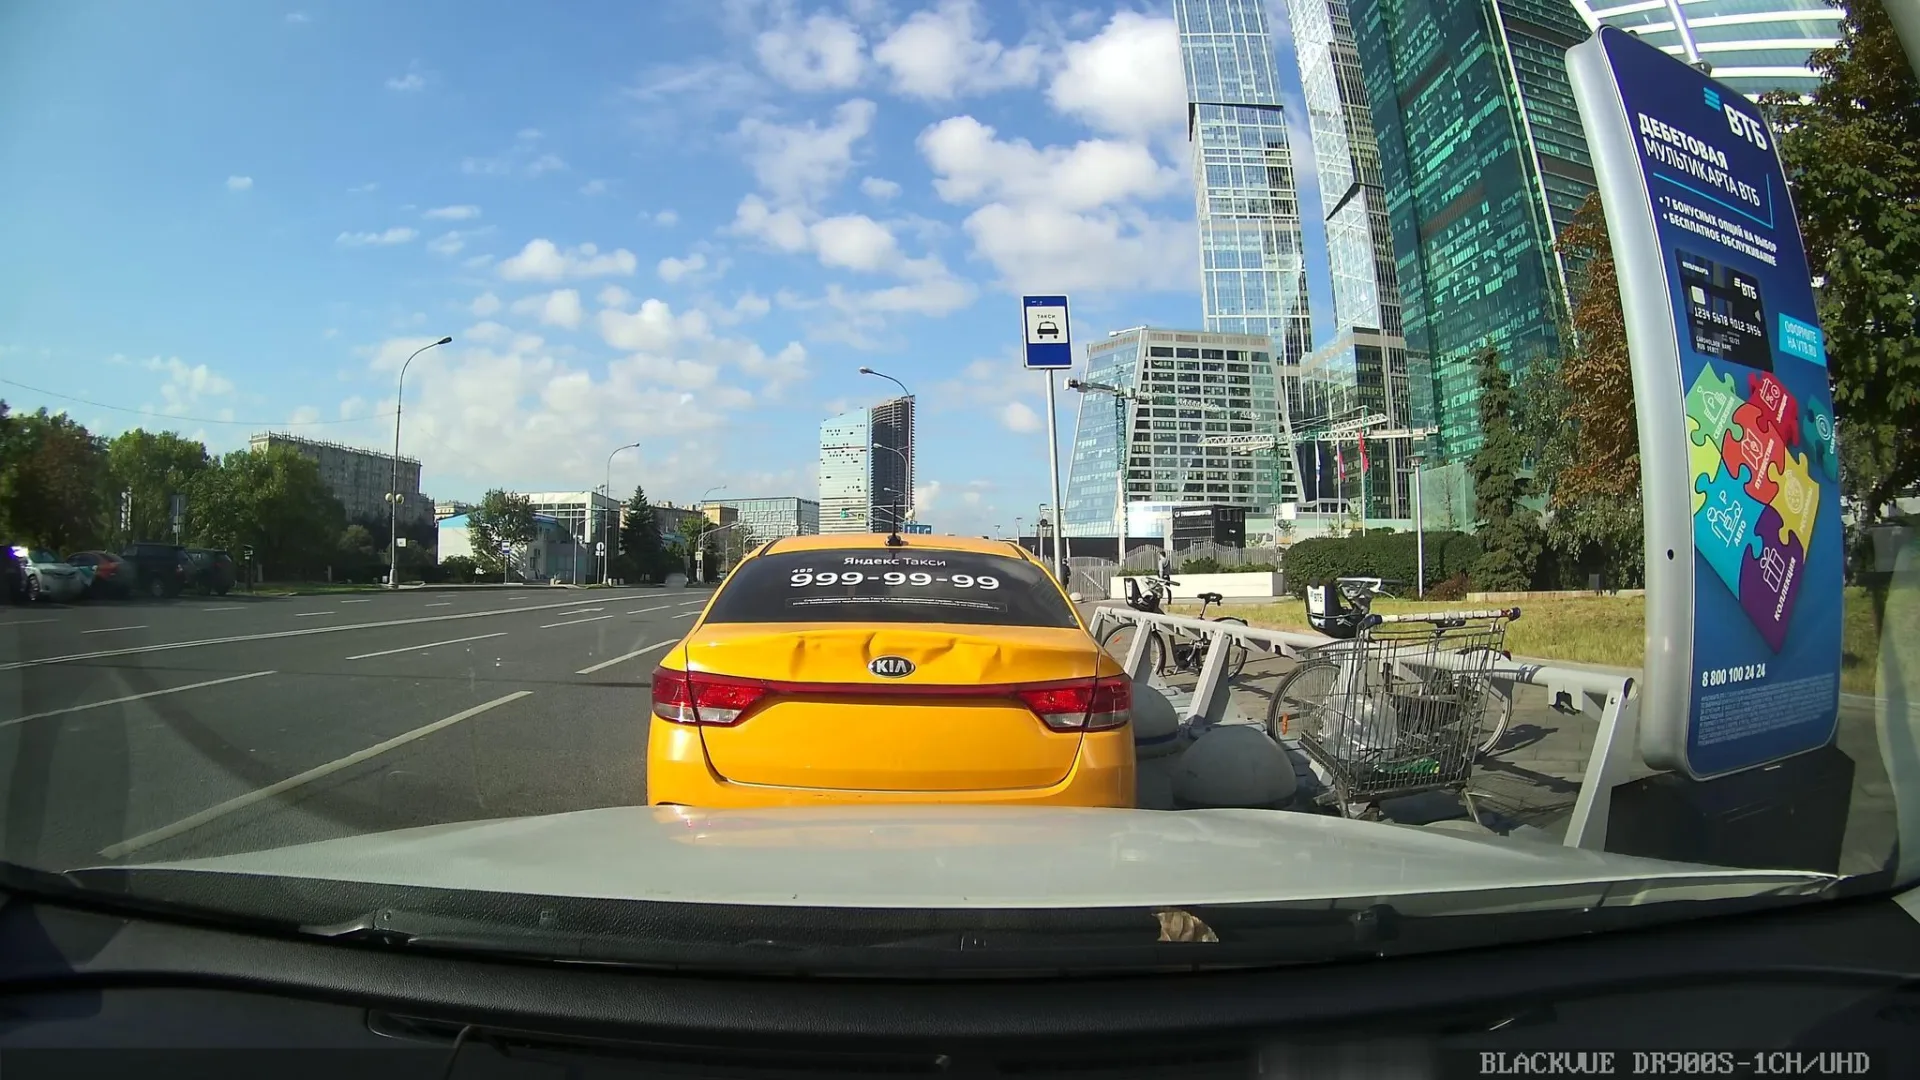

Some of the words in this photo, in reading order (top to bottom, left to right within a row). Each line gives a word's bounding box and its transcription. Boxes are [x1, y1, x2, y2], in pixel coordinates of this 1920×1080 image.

[1638, 112, 1729, 171] ДЕБЕТОВАЯ
[1723, 103, 1768, 151] ВТБ
[1643, 136, 1739, 197] МУЛЬТИКАРТА
[1738, 181, 1761, 207] ВТБ
[1664, 196, 1671, 208] 7
[1672, 199, 1718, 227] БОНУСНЫХ
[1743, 229, 1755, 244] НА
[1669, 212, 1721, 242] БЕСПЛАТНОЕ
[1721, 234, 1777, 267] ОБСЛУЖИВАНИЕ
[1741, 282, 1757, 300] ВТБ
[1694, 306, 1710, 321] 1234
[1712, 312, 1729, 326] 5678
[1730, 317, 1745, 332] 9012
[1747, 323, 1762, 337] 3456
[1733, 520, 1747, 547] АВТО
[843, 557, 900, 566] Яндекс
[902, 557, 946, 566] Такси
[790, 572, 1000, 590] 999-99-99
[1774, 557, 1797, 621] КОЛЛЕКЦИЯ
[876, 660, 907, 674] KIA
[1702, 671, 1709, 687] 8
[1710, 668, 1727, 686] 800
[1729, 666, 1743, 683] 100
[1745, 664, 1755, 681] 24
[1756, 663, 1766, 679] 24
